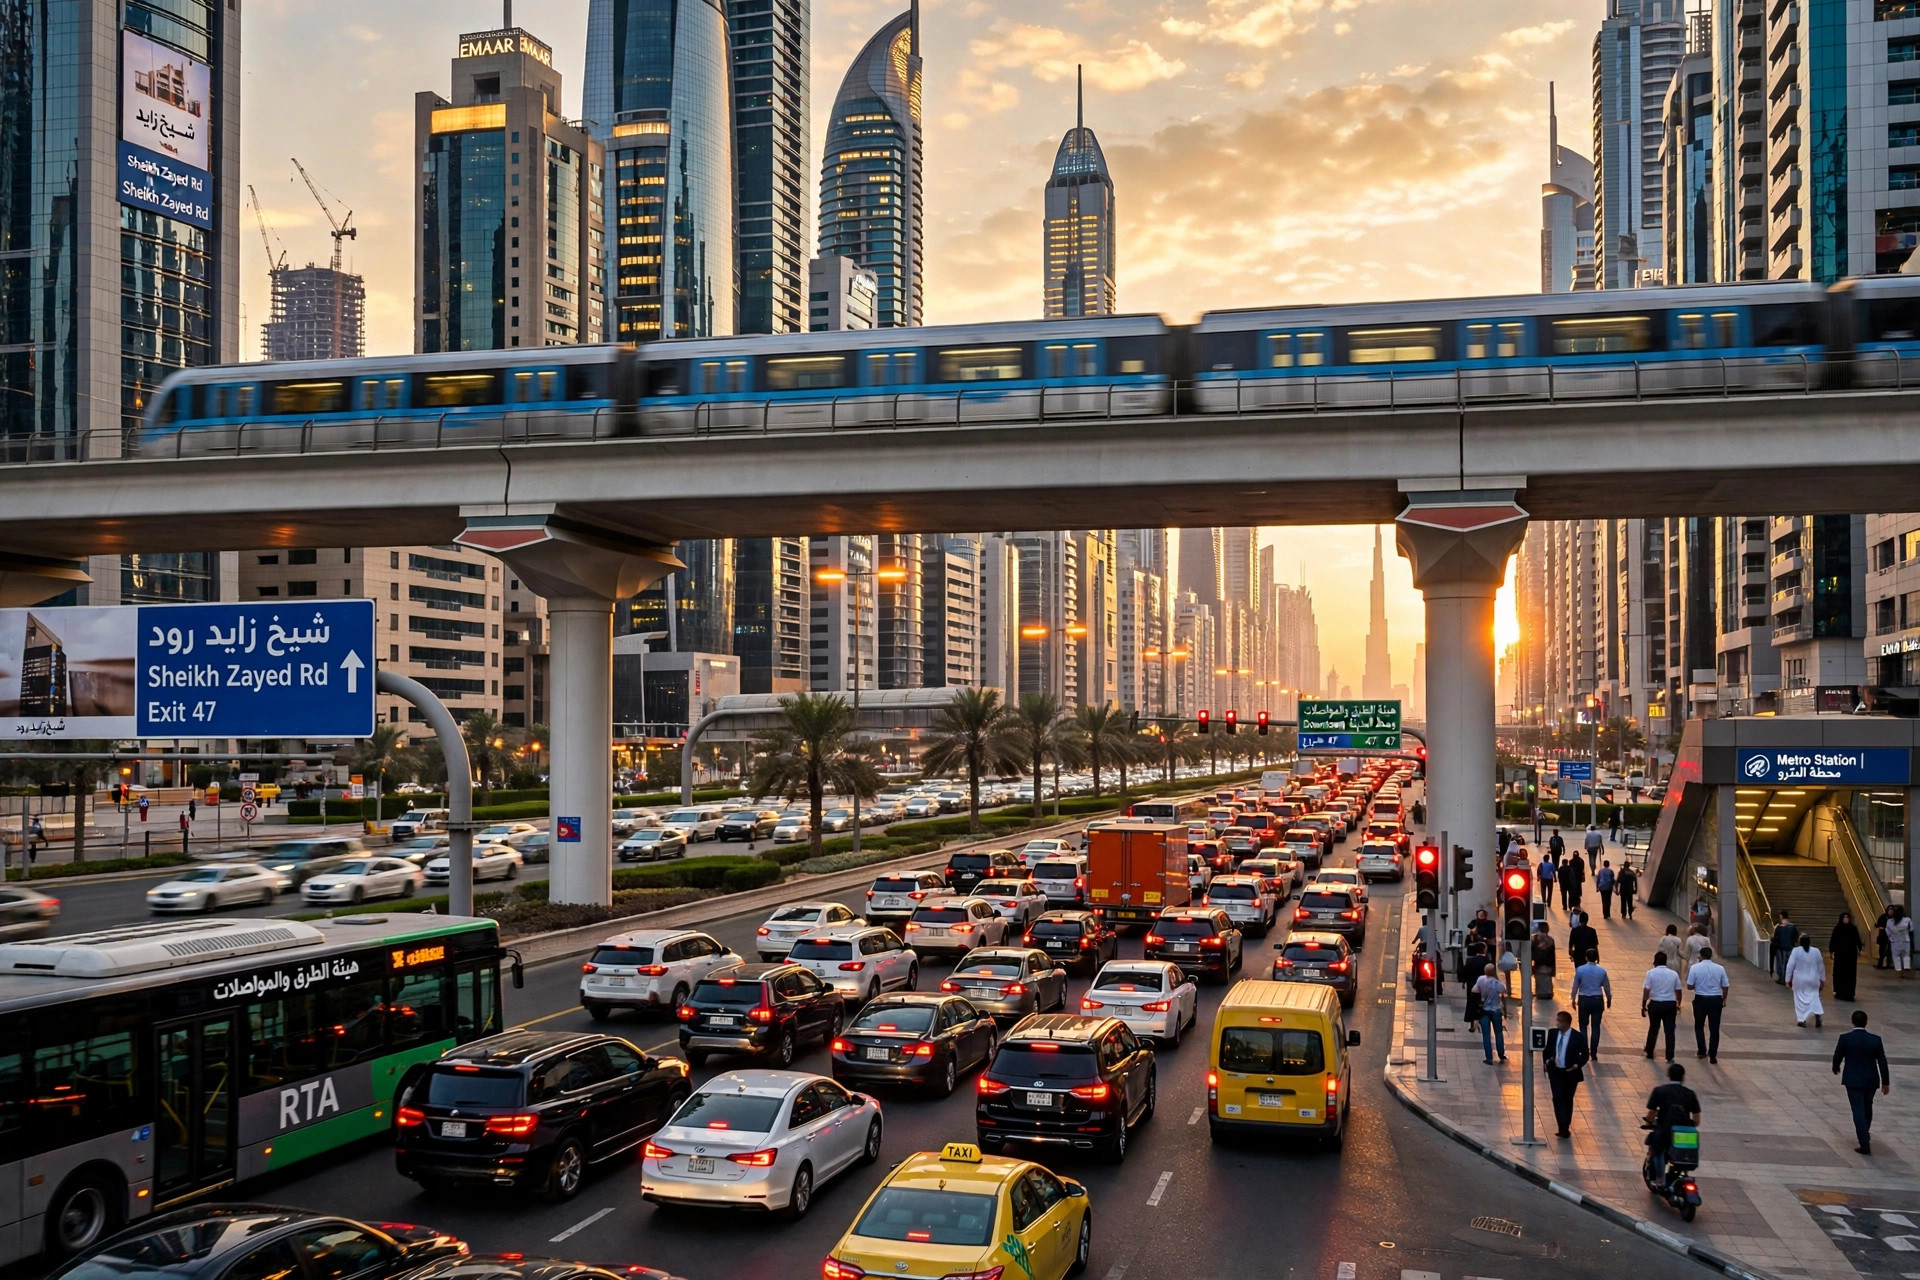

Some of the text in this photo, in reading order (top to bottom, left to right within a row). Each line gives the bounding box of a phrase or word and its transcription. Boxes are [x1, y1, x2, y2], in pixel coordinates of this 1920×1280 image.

[460, 38, 515, 58] EMAAR
[136, 108, 195, 140] شيخ زايد
[191, 176, 203, 192] Rd
[122, 180, 209, 220] Sheikh Zayed Rd
[149, 612, 330, 657] شيخ زايد رود
[148, 662, 328, 692] Sheikh Zayed Rd
[148, 700, 217, 722] Exit 47
[1777, 754, 1856, 766] Metro Station
[1809, 766, 1841, 778] محطة
[213, 958, 360, 1000] هيئة الطرق والمواصلات
[280, 1077, 340, 1130] RTA
[948, 1146, 972, 1158] TAXI
